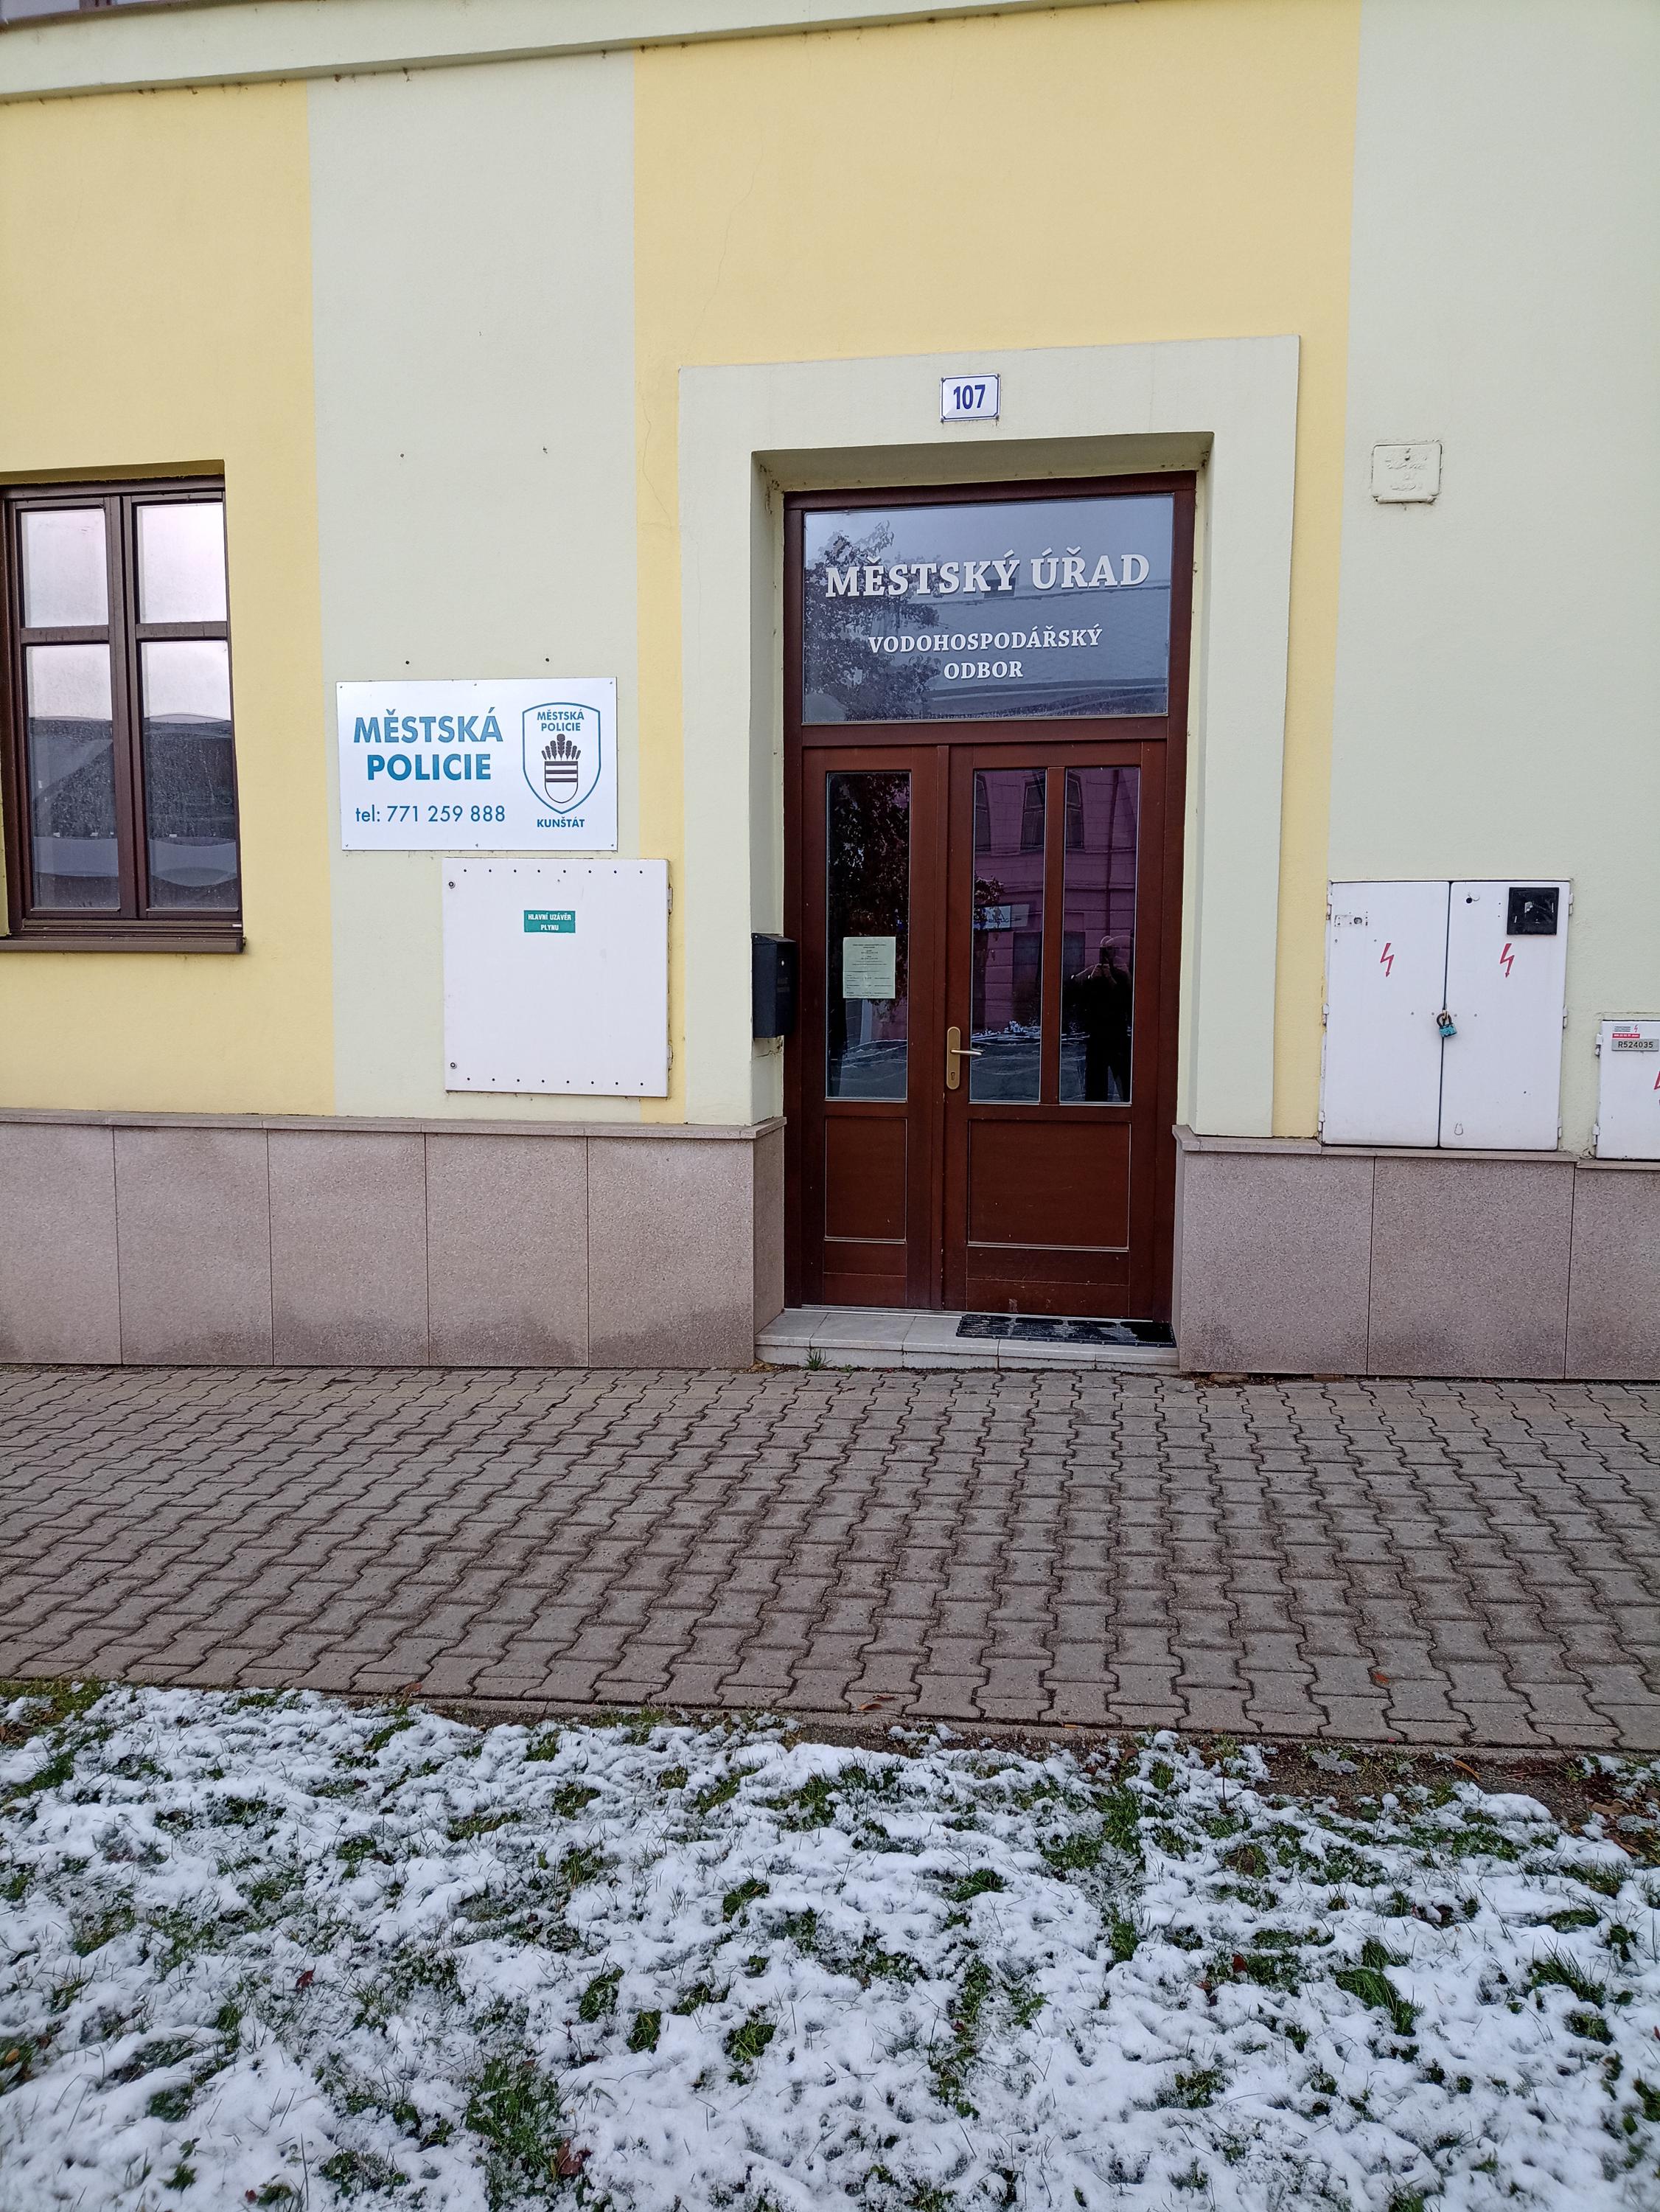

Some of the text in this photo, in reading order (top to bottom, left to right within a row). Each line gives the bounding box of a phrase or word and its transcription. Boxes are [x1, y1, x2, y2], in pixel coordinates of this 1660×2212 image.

[953, 384, 986, 410] 107
[825, 546, 1151, 598] MĚSTSKÝ ÚŘAD
[868, 623, 1103, 654] VODOHOSPODÁŘSKÝ
[944, 661, 1024, 681] ODBOR
[537, 708, 585, 721] MĚSTSKÁ
[353, 706, 503, 744] MĚSTSKÁ
[541, 722, 581, 732] POLICIE
[367, 753, 492, 781] POLICIE
[355, 804, 506, 822] tel: 771 259 888
[537, 816, 585, 828] KUNŠTÁT
[528, 911, 571, 921] HLAVNÍ UZÁVĚR
[1617, 1040, 1653, 1048] R524035
